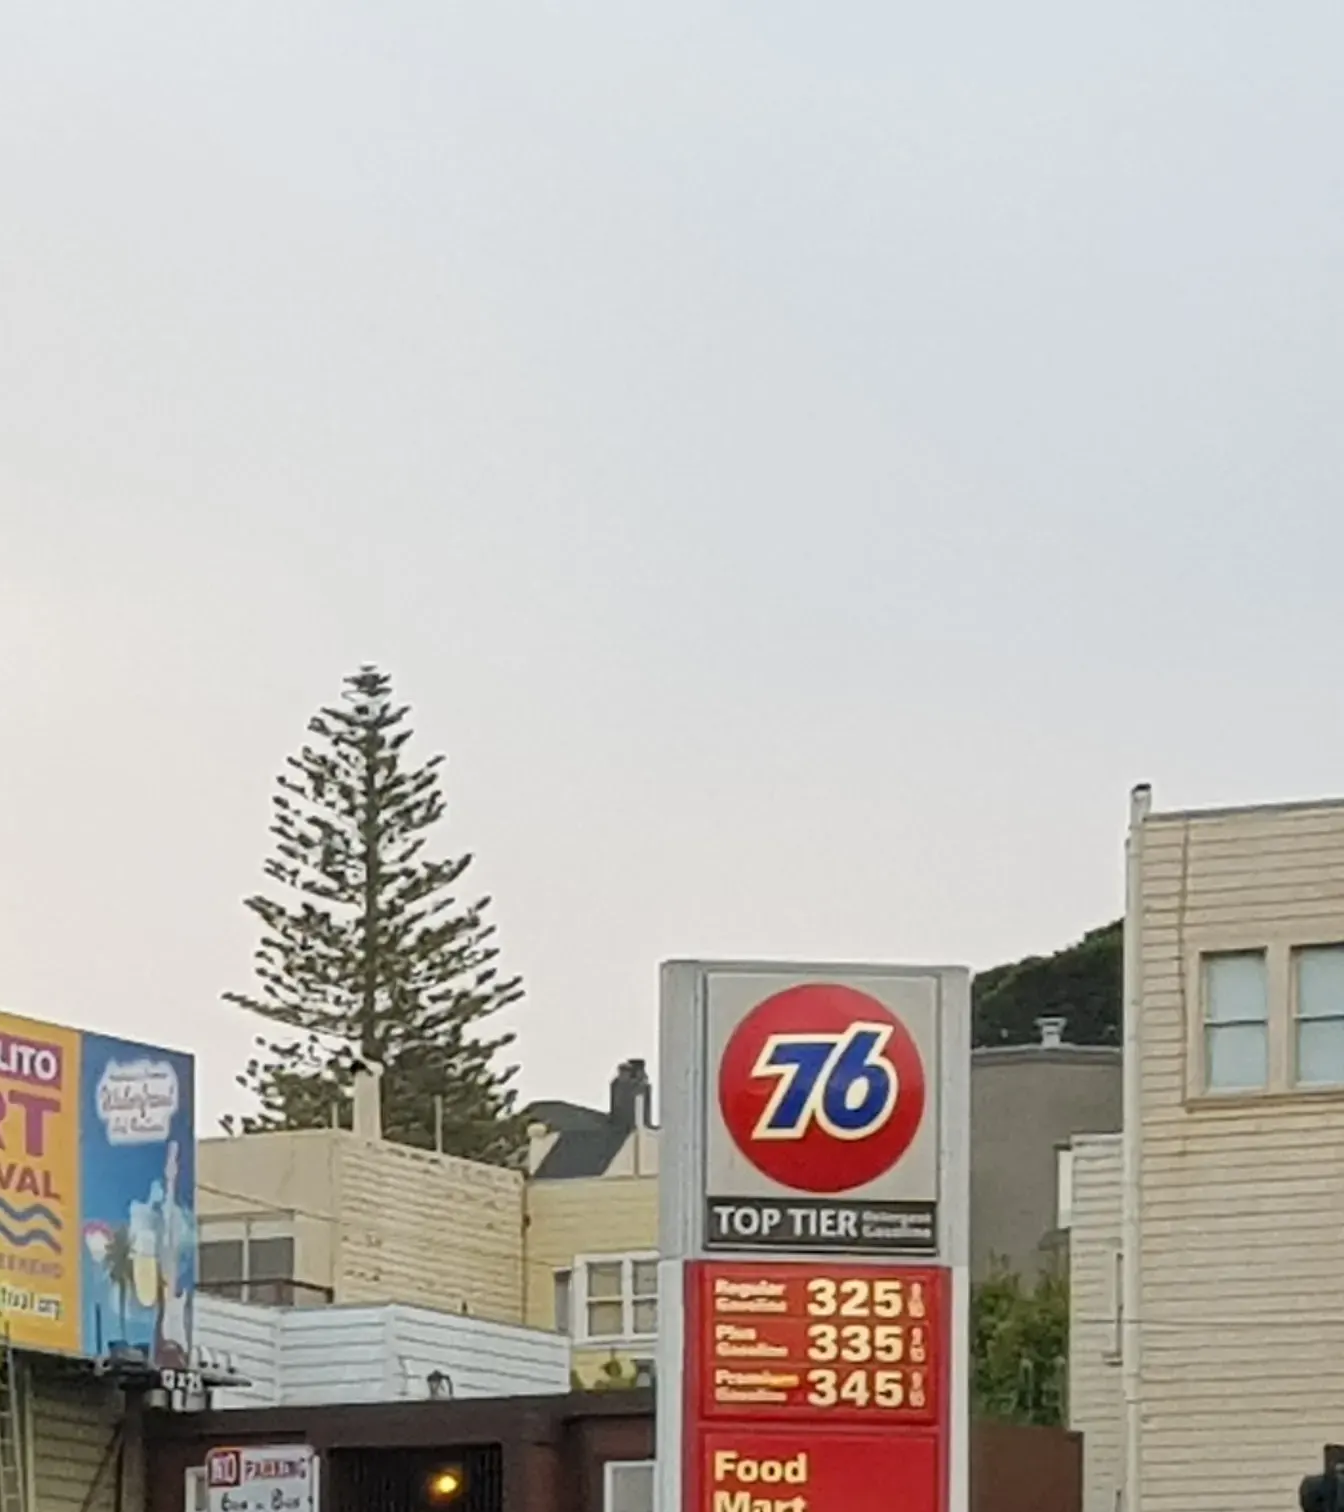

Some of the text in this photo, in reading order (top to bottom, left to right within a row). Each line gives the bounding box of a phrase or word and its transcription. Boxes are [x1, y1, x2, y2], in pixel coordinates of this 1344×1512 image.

[750, 1021, 900, 1142] 76
[713, 1206, 858, 1238] TOP TIER
[807, 1278, 904, 1317] 325
[807, 1324, 905, 1362] 335
[807, 1369, 906, 1408] 345
[713, 1451, 808, 1482] Food
